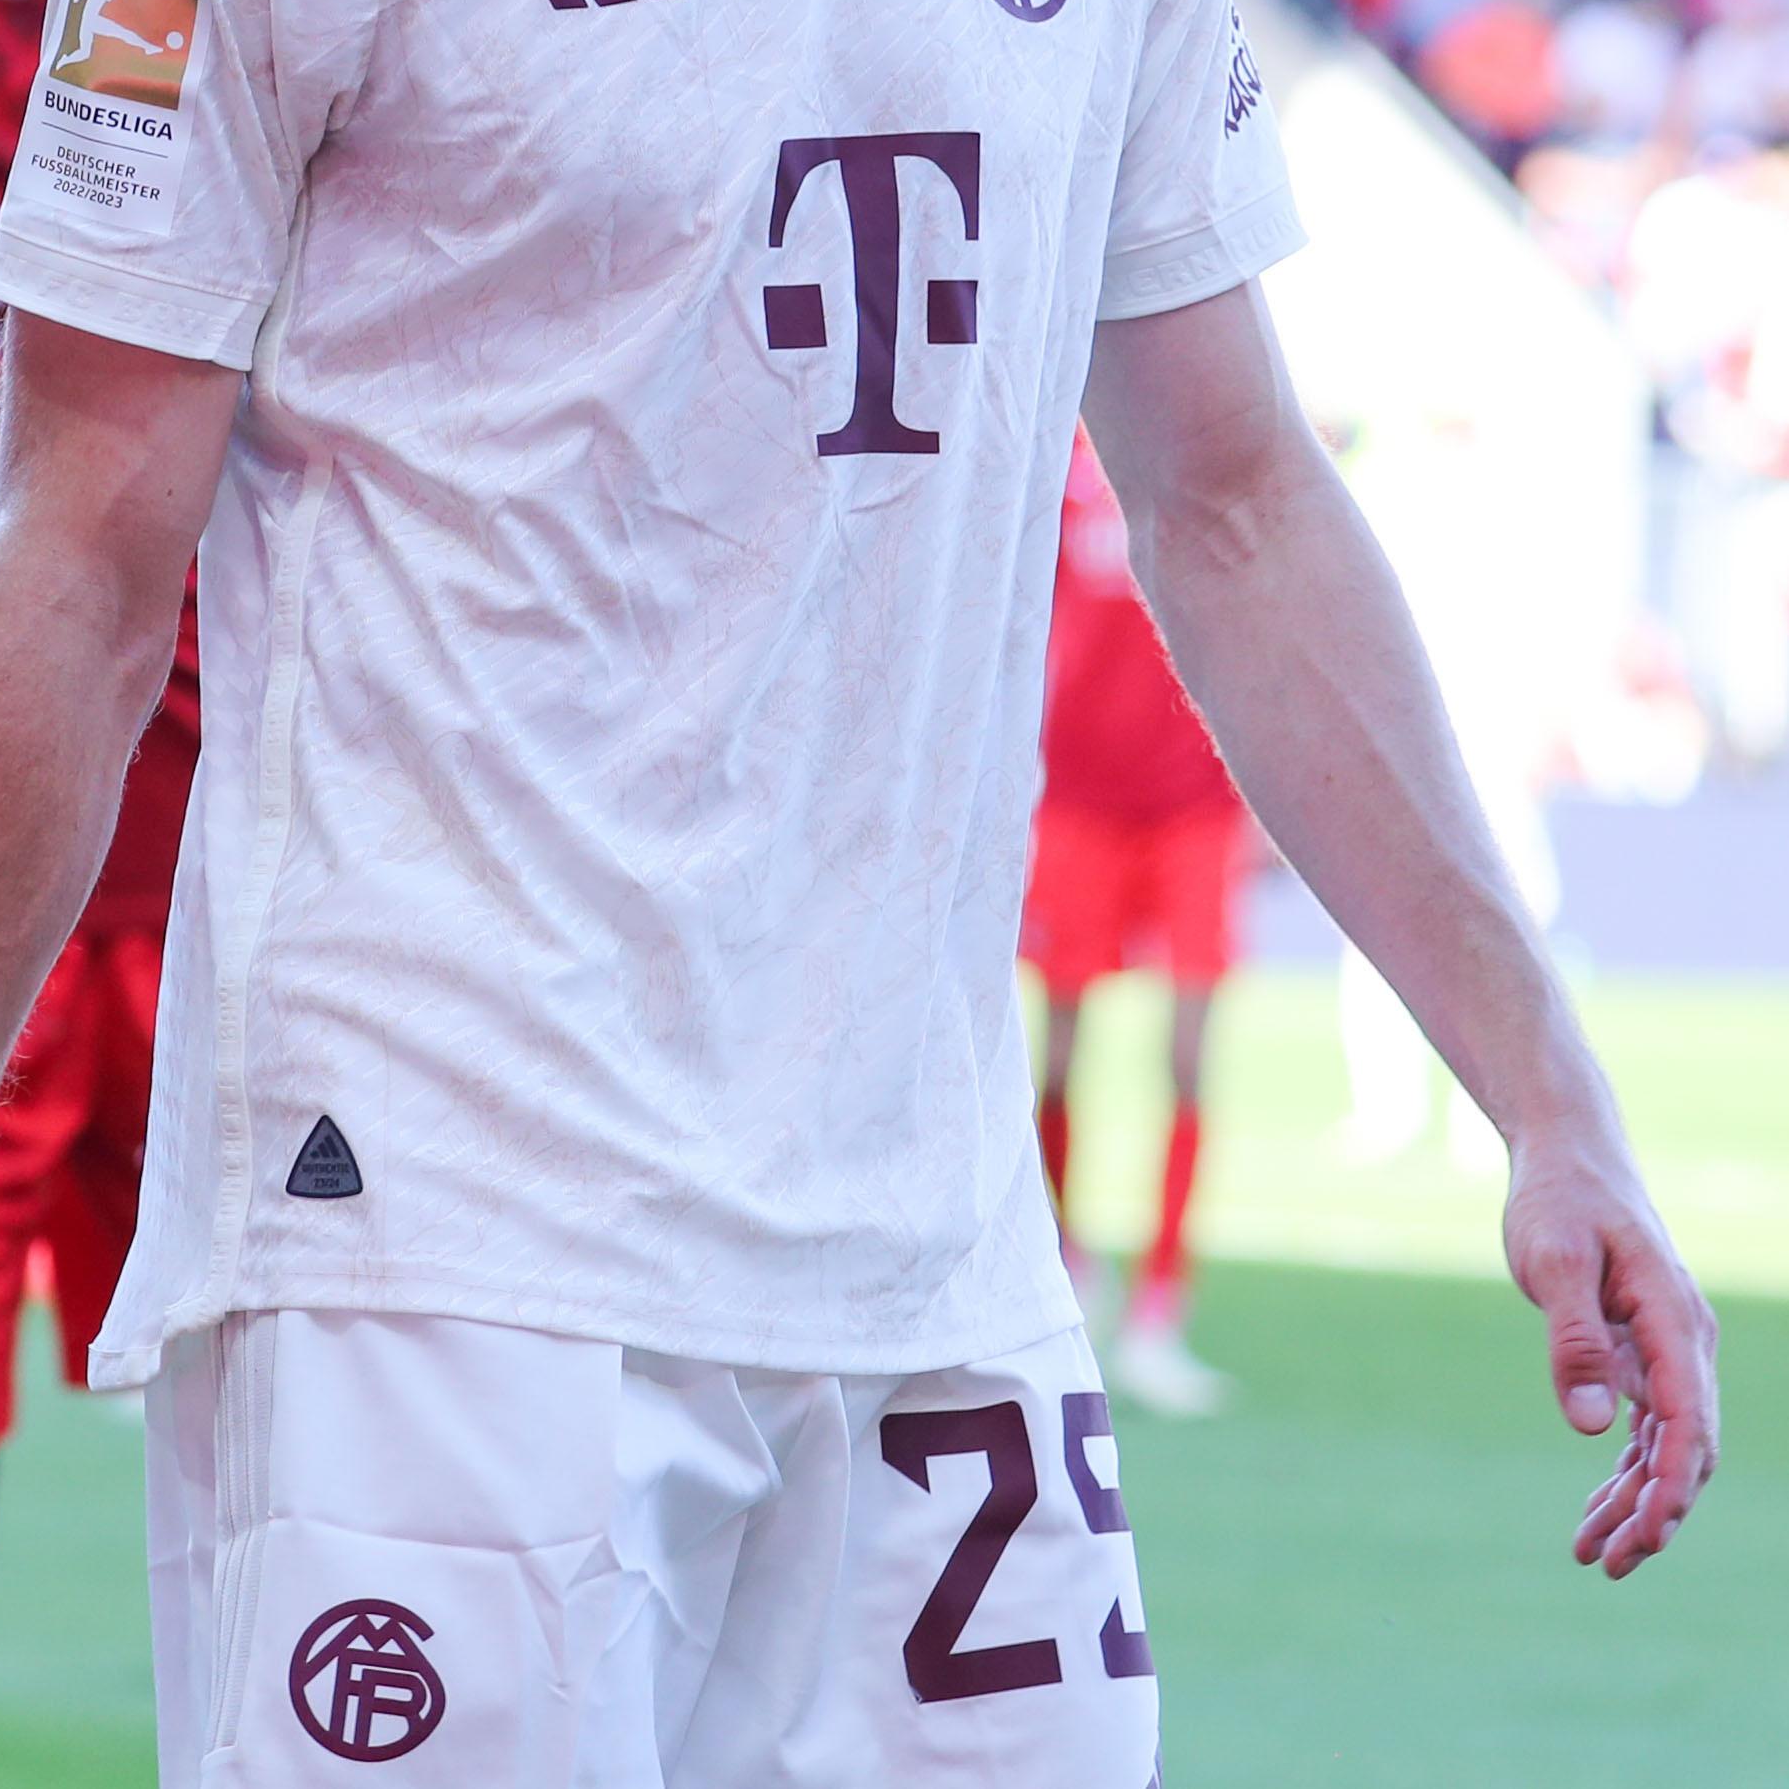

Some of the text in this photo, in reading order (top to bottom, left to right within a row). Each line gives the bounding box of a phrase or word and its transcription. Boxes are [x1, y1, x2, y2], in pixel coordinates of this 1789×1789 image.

[44, 90, 174, 141] BUNDESLIGA
[31, 154, 161, 201] FUSSBALLMEISTER
[56, 145, 137, 179] DEUTSCHER
[53, 178, 123, 209] 2022/2023
[768, 132, 981, 457] T
